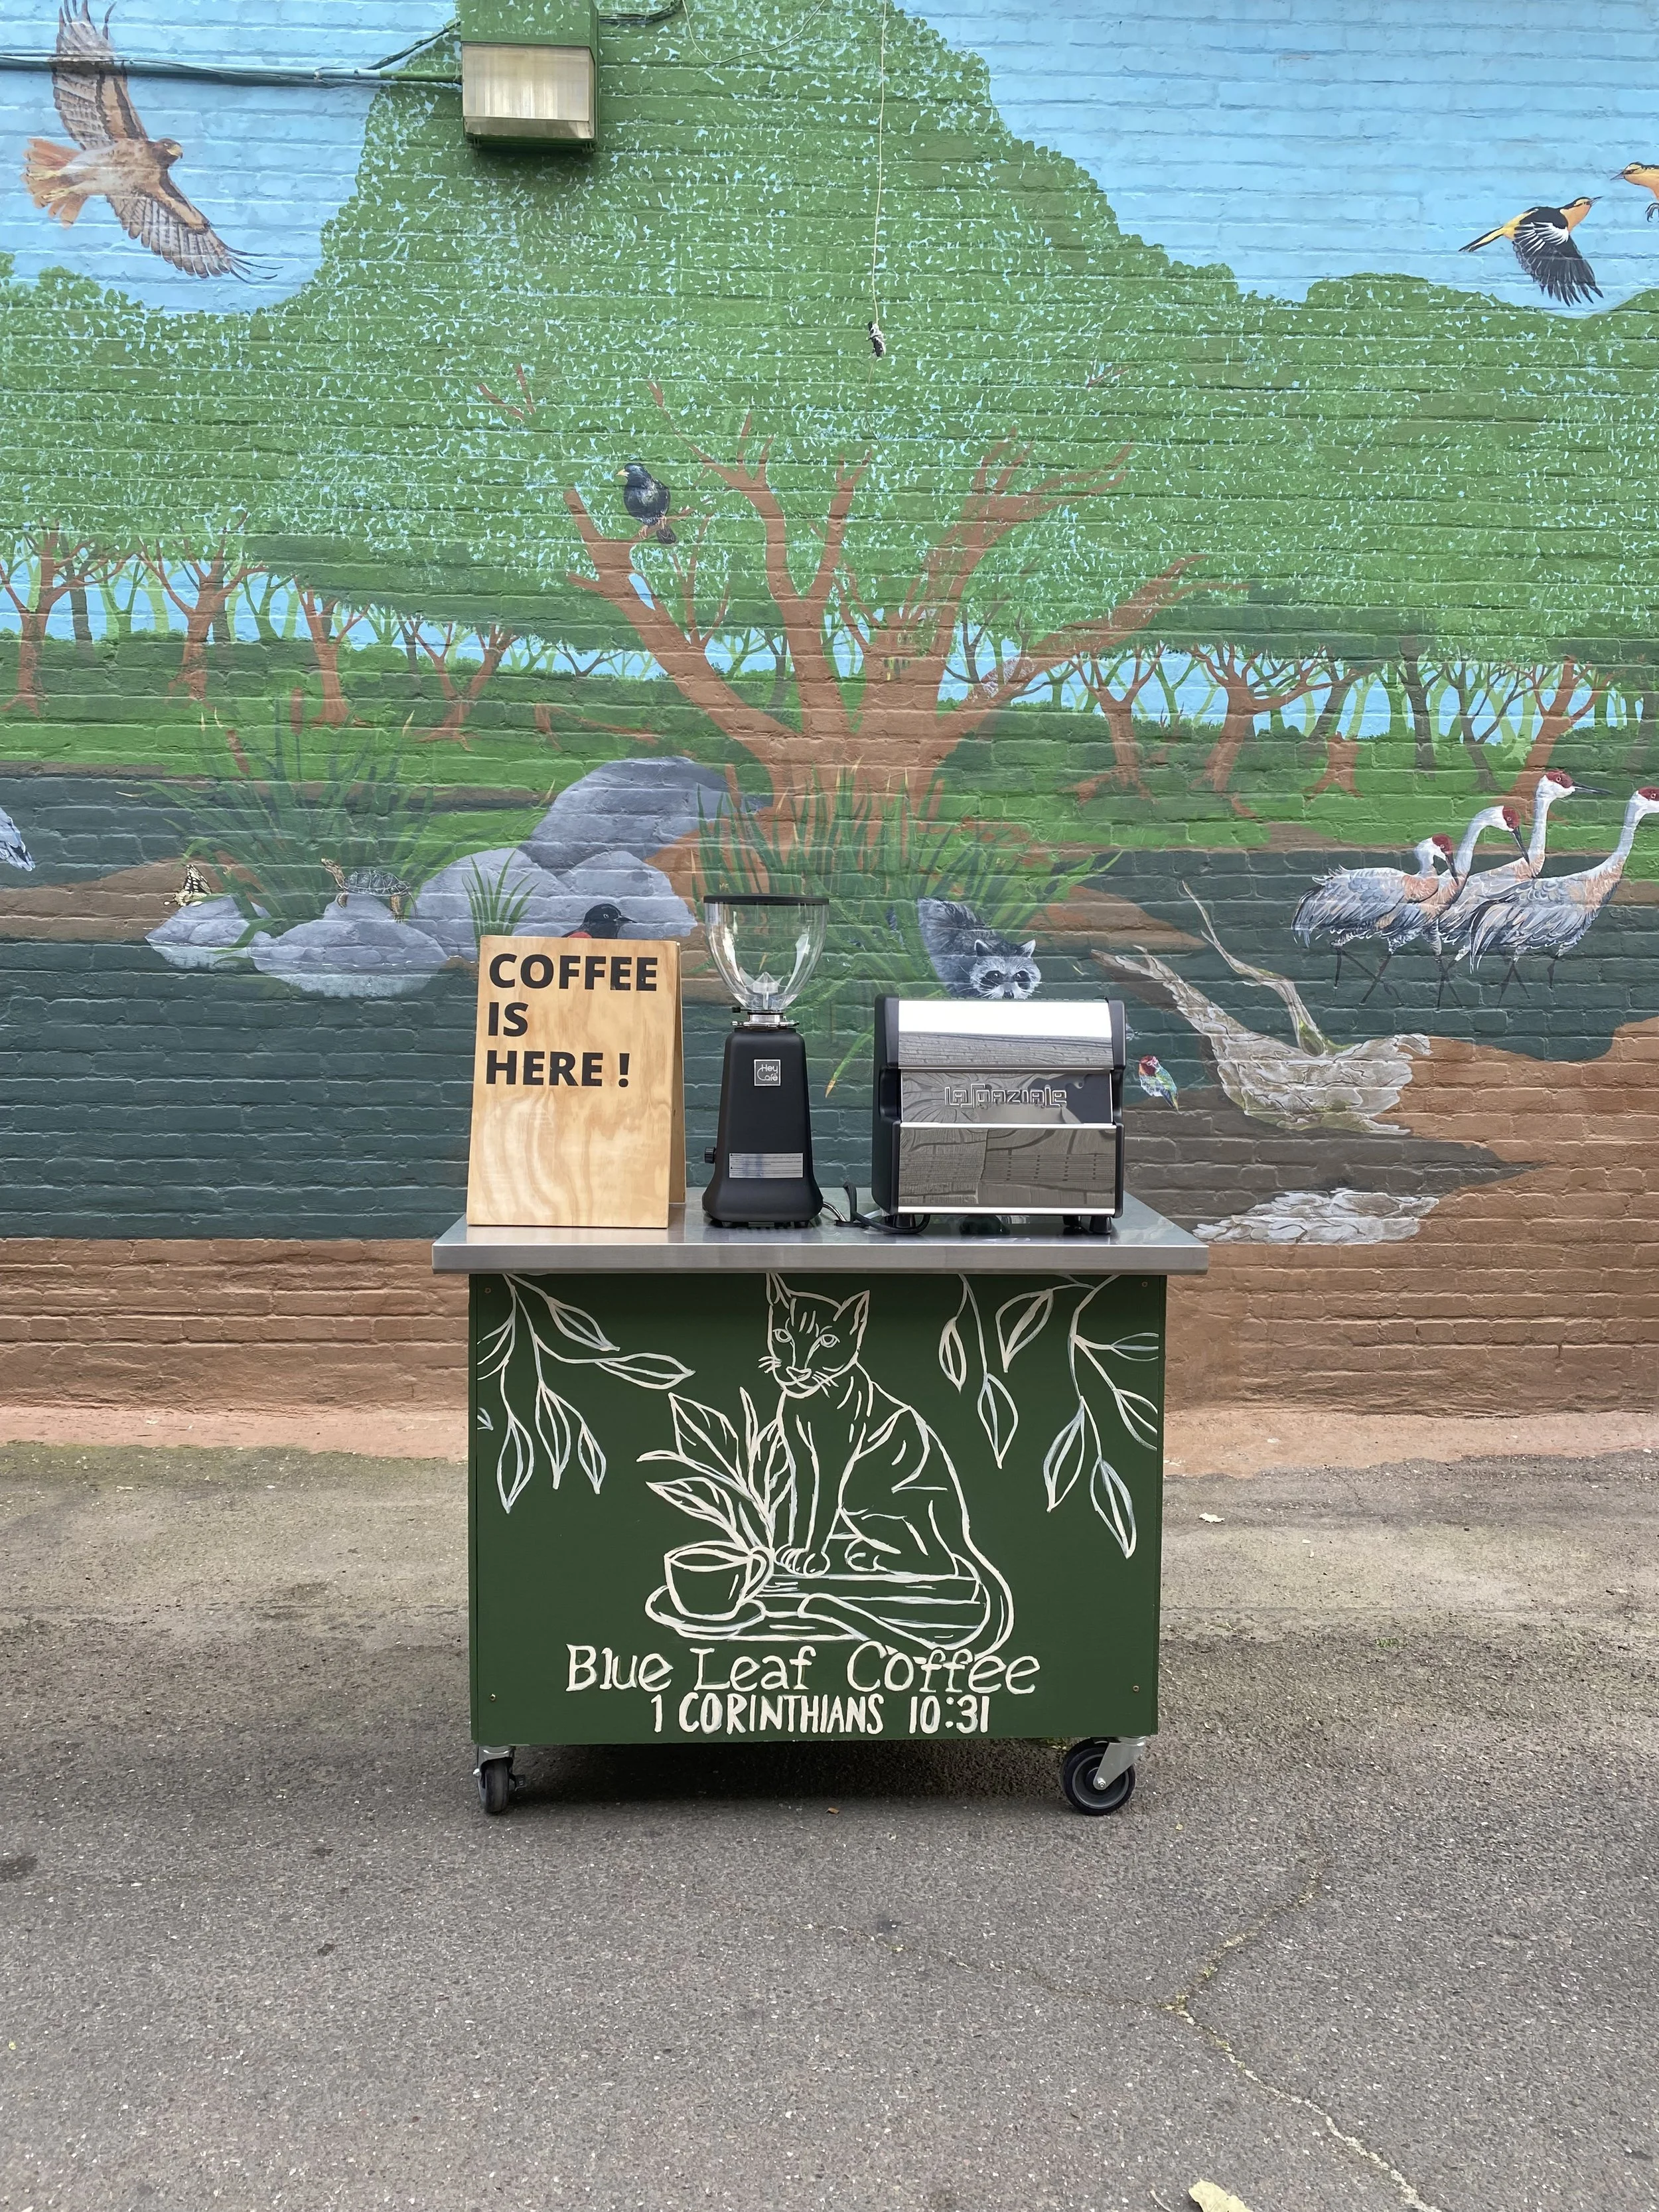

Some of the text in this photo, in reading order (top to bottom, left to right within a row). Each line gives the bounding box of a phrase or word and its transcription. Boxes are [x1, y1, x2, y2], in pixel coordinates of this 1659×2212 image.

[489, 953, 658, 992] COFFEE
[488, 1001, 528, 1037] IS
[486, 1050, 603, 1087] HERE
[761, 1064, 778, 1074] Hey
[565, 1641, 1041, 1694] Blue Leaf Coffee
[650, 1692, 990, 1735] 1 CORINTHIANS 10:31
